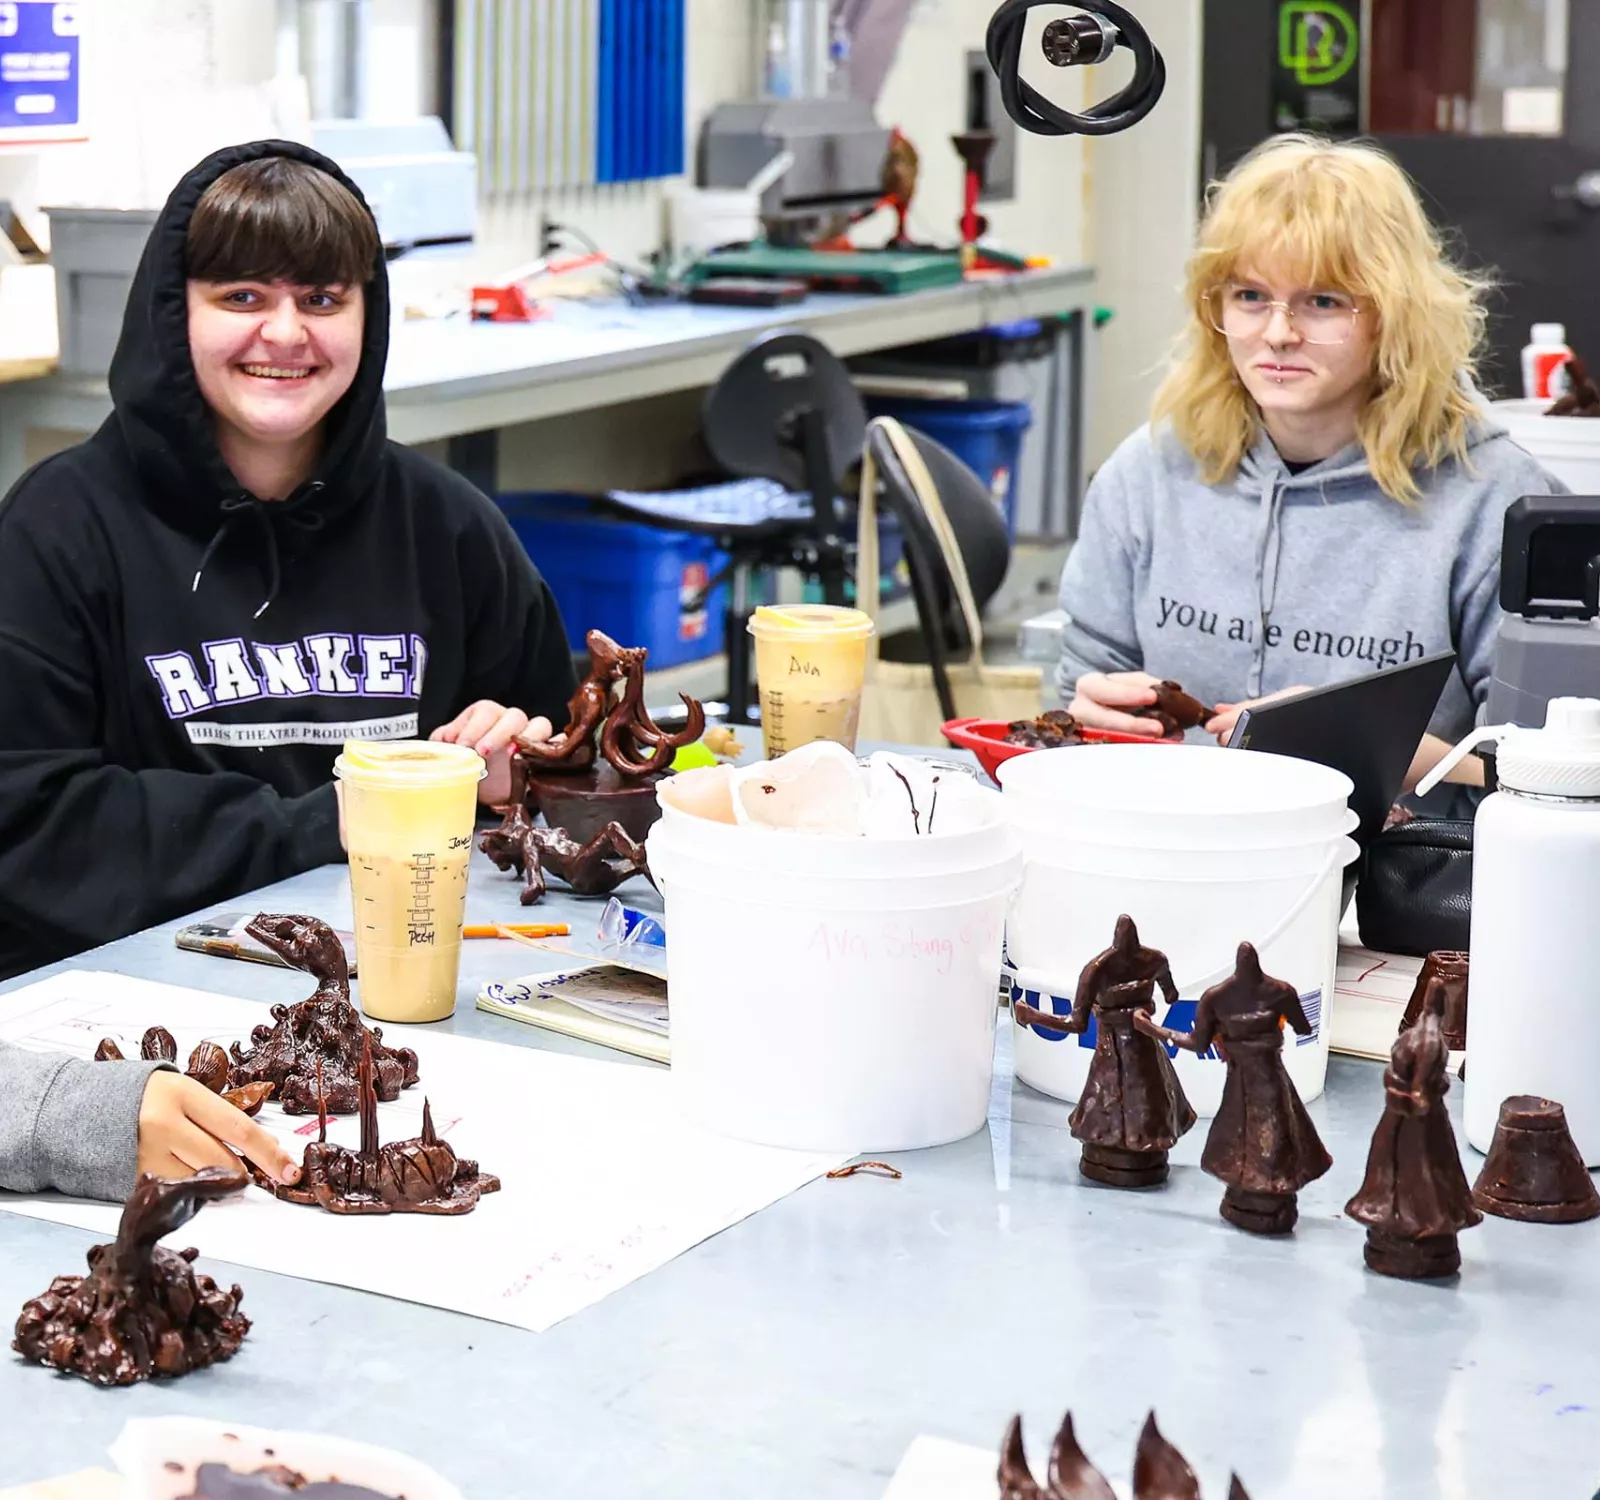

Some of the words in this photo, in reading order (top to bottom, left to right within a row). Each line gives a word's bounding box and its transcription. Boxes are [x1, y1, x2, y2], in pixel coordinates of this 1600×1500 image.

[1155, 596, 1218, 636] you
[1293, 629, 1426, 670] enough
[788, 655, 822, 677] Ava
[236, 728, 299, 741] THEATRE
[302, 723, 393, 740] PRODUCTION
